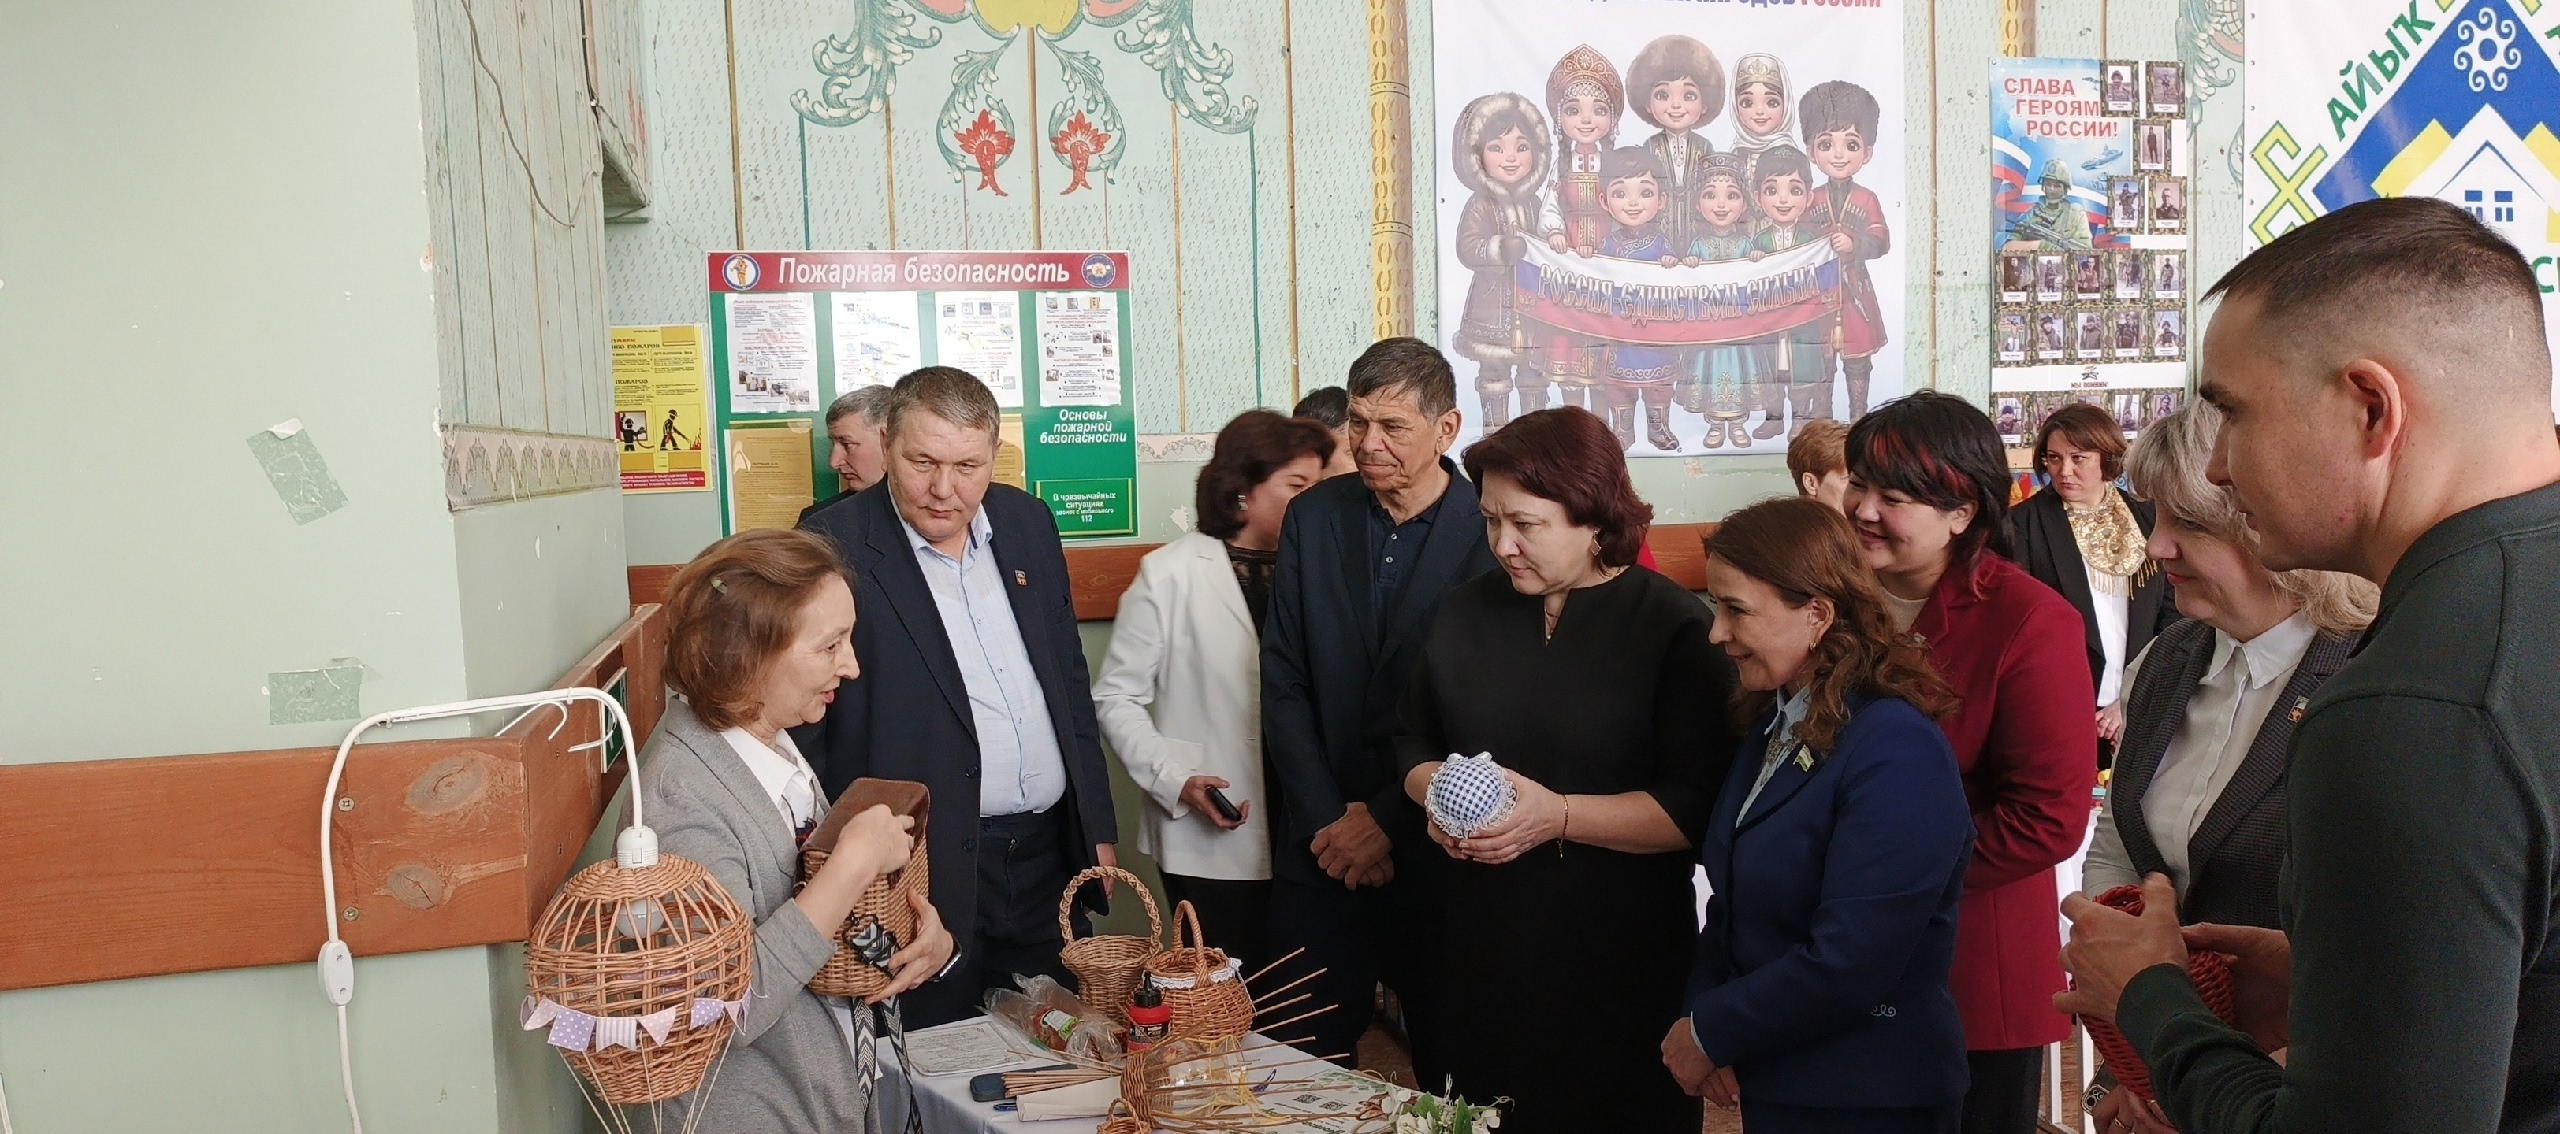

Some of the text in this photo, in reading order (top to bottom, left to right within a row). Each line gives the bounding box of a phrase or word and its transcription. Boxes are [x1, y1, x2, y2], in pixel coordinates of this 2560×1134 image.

[2003, 77, 2076, 96] СЛАВА
[2015, 99, 2100, 117] ГЕРОЯМ
[2026, 119, 2120, 138] РОССИИ!
[778, 256, 1071, 290] Пожарная безопасность
[1059, 408, 1108, 422] Основы
[1053, 421, 1113, 435] пожарной
[1039, 431, 1127, 444] безопасности
[1053, 493, 1060, 502] В
[1081, 515, 1093, 523] 112
